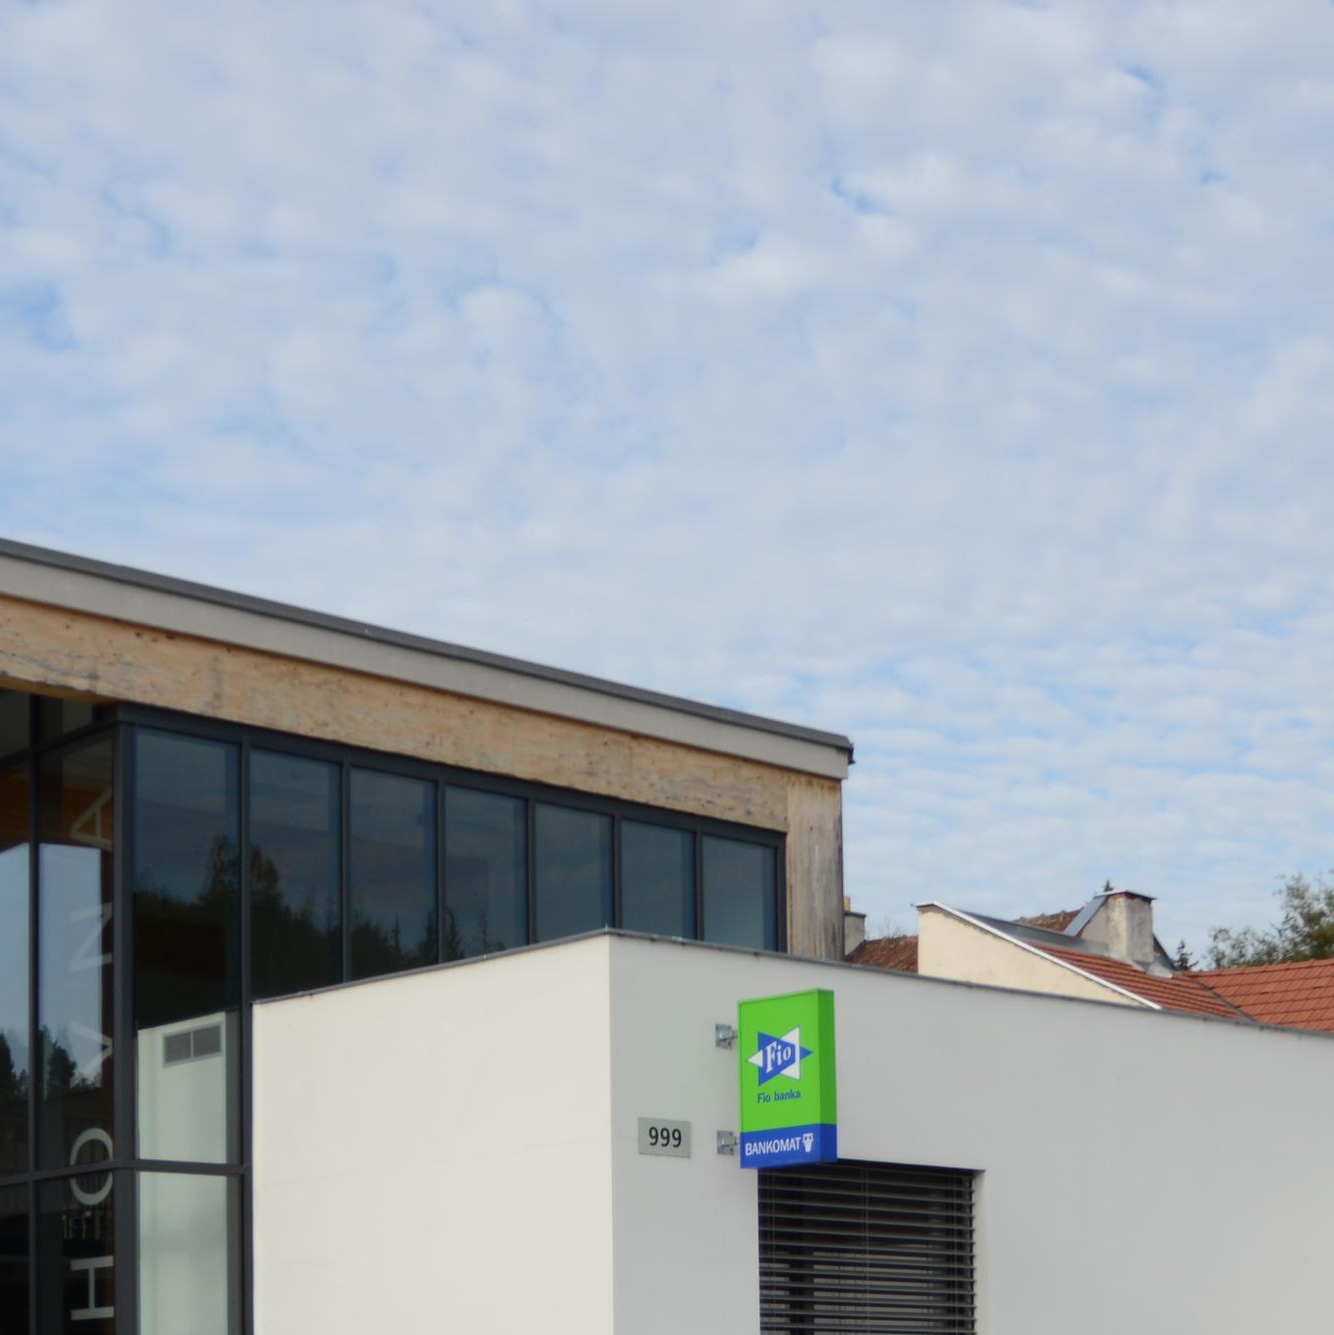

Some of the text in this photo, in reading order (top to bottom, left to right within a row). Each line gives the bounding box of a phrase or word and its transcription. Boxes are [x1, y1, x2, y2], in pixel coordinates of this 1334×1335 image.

[765, 1040, 792, 1073] Fio
[756, 1089, 801, 1104] Fio banka
[648, 1126, 682, 1149] 999
[745, 1136, 802, 1156] BANKOMAT
